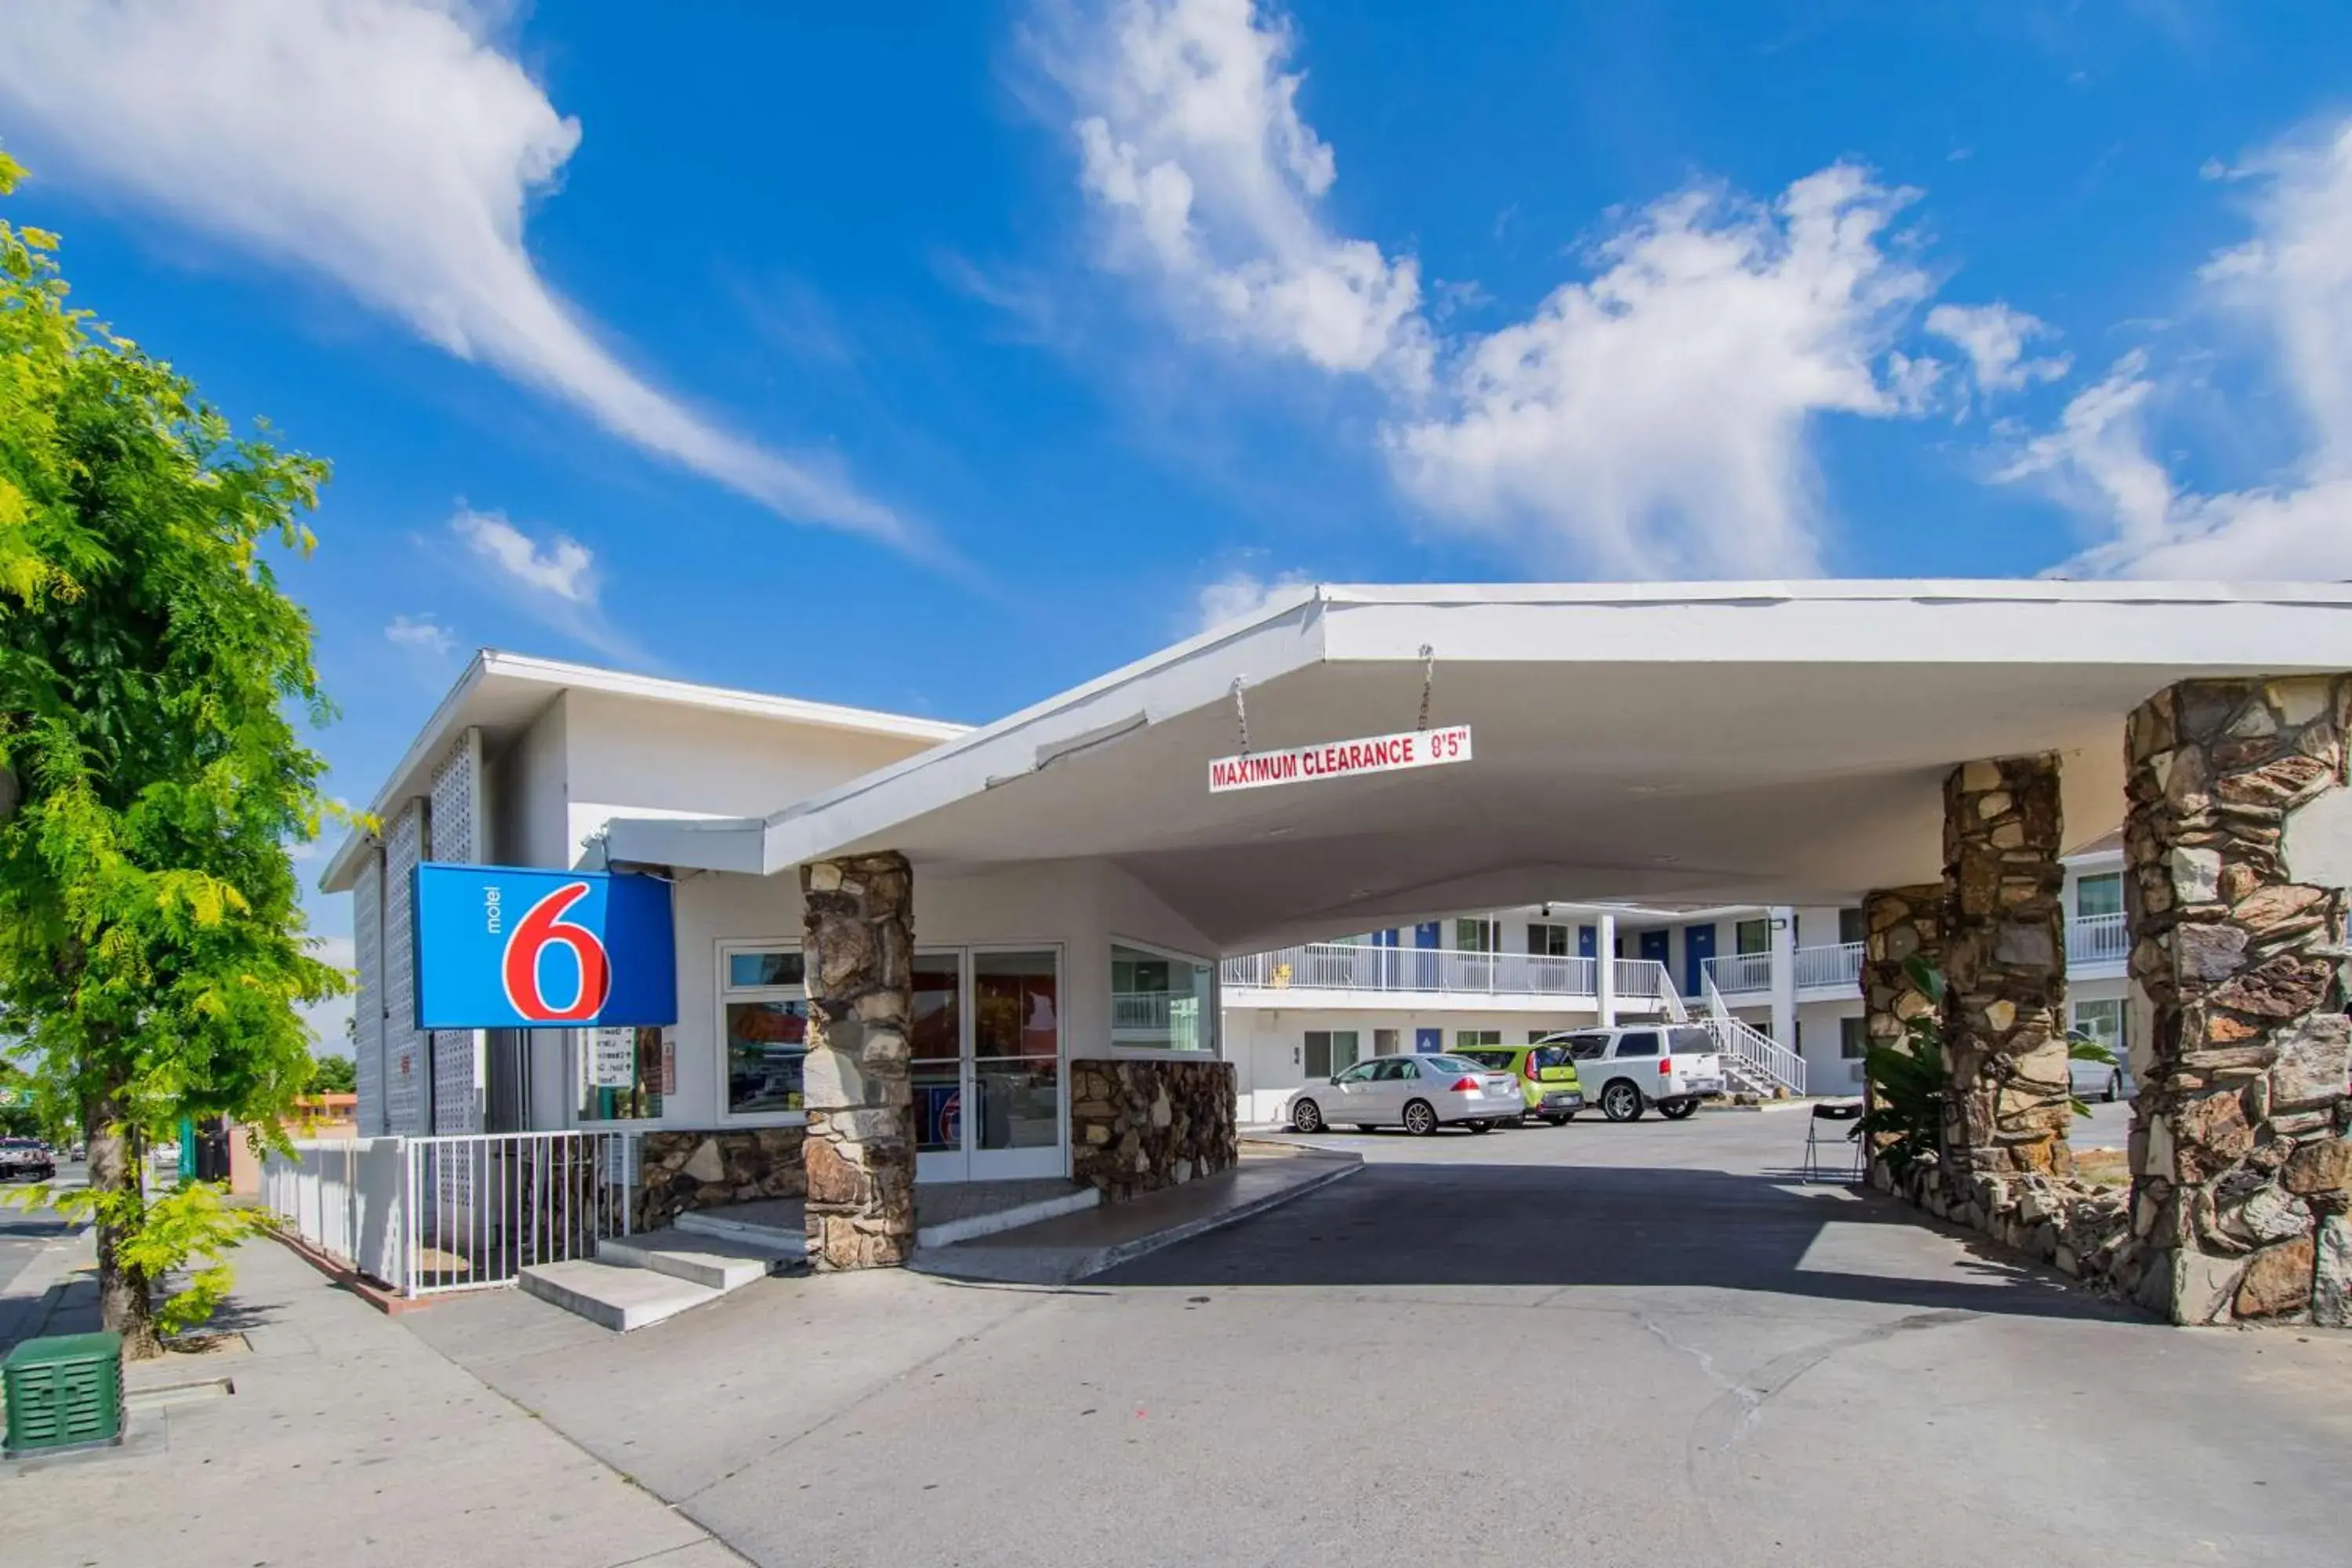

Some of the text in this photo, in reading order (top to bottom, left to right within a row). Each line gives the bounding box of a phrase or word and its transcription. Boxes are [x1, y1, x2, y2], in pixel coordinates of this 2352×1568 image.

[1213, 731, 1467, 786] MAXIMUM CLEARANCE 8'5"
[483, 881, 612, 1021] motel 6
